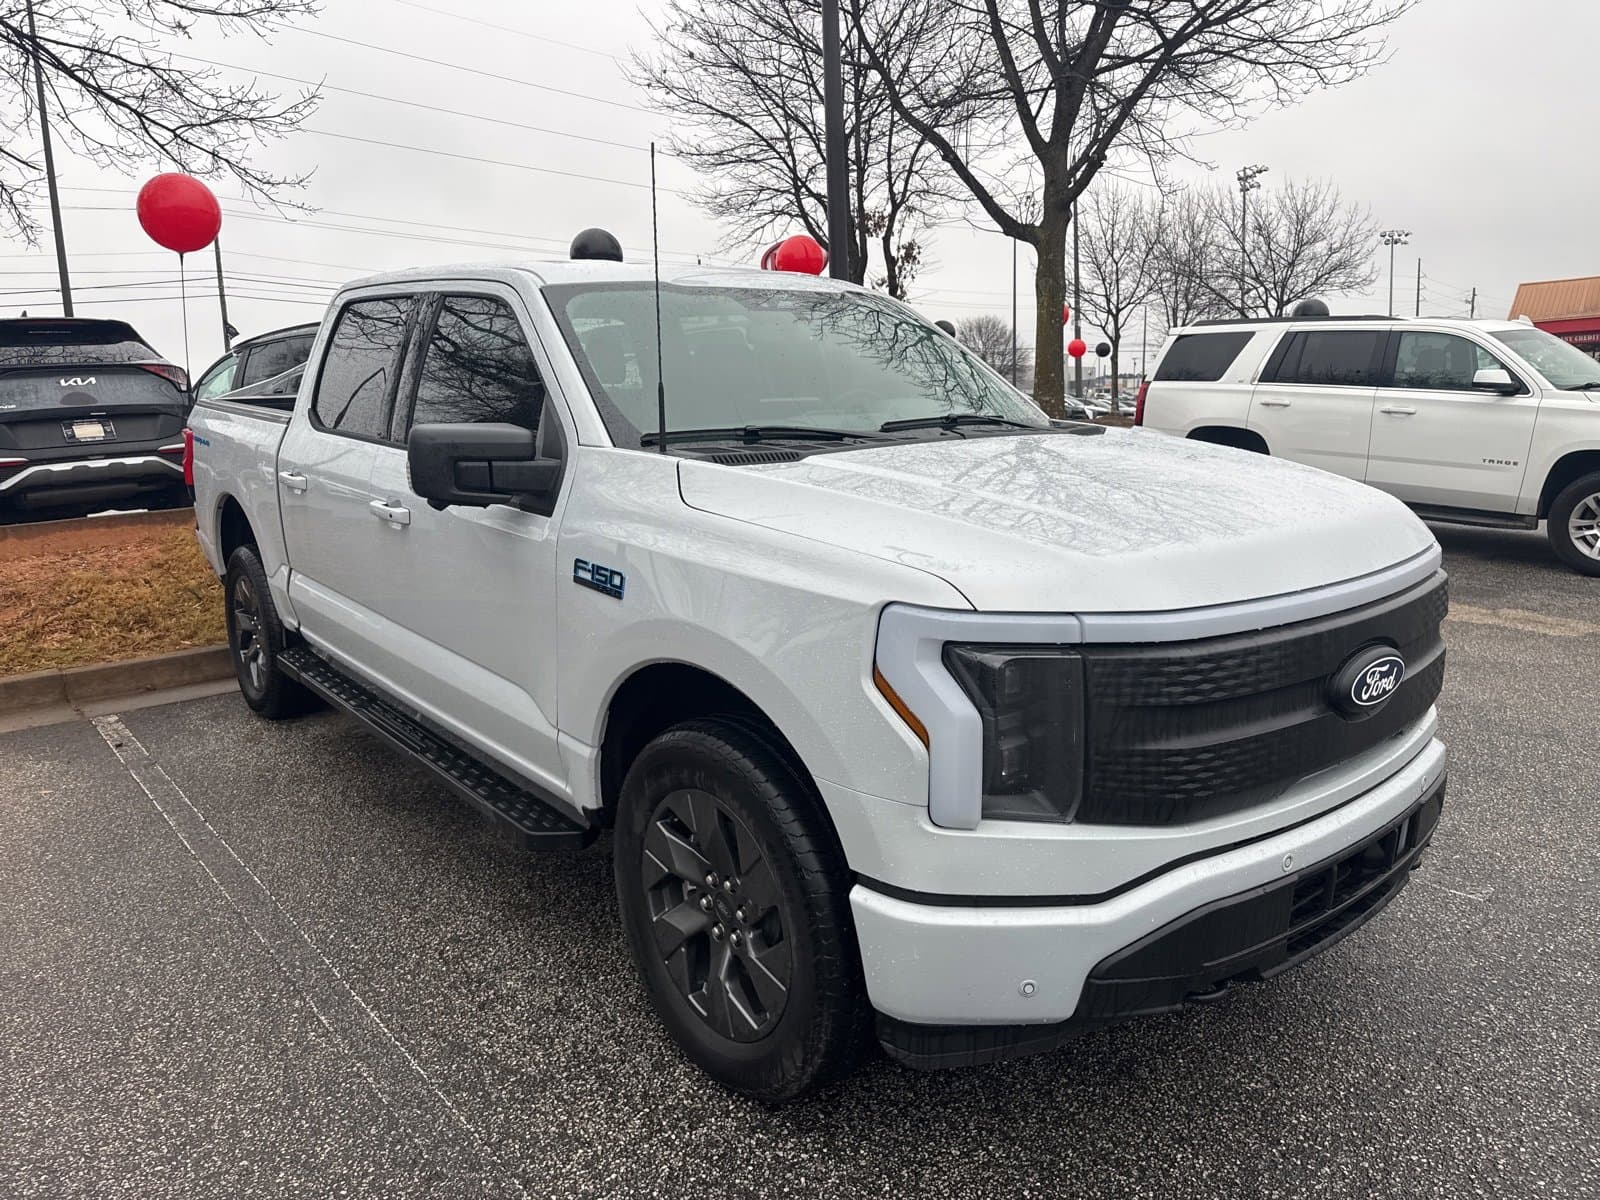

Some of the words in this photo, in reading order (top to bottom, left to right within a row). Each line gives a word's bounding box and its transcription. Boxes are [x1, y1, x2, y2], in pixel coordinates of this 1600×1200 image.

[1482, 458, 1519, 466] TAHOE
[573, 557, 625, 592] F-150
[1361, 663, 1398, 700] Ford
